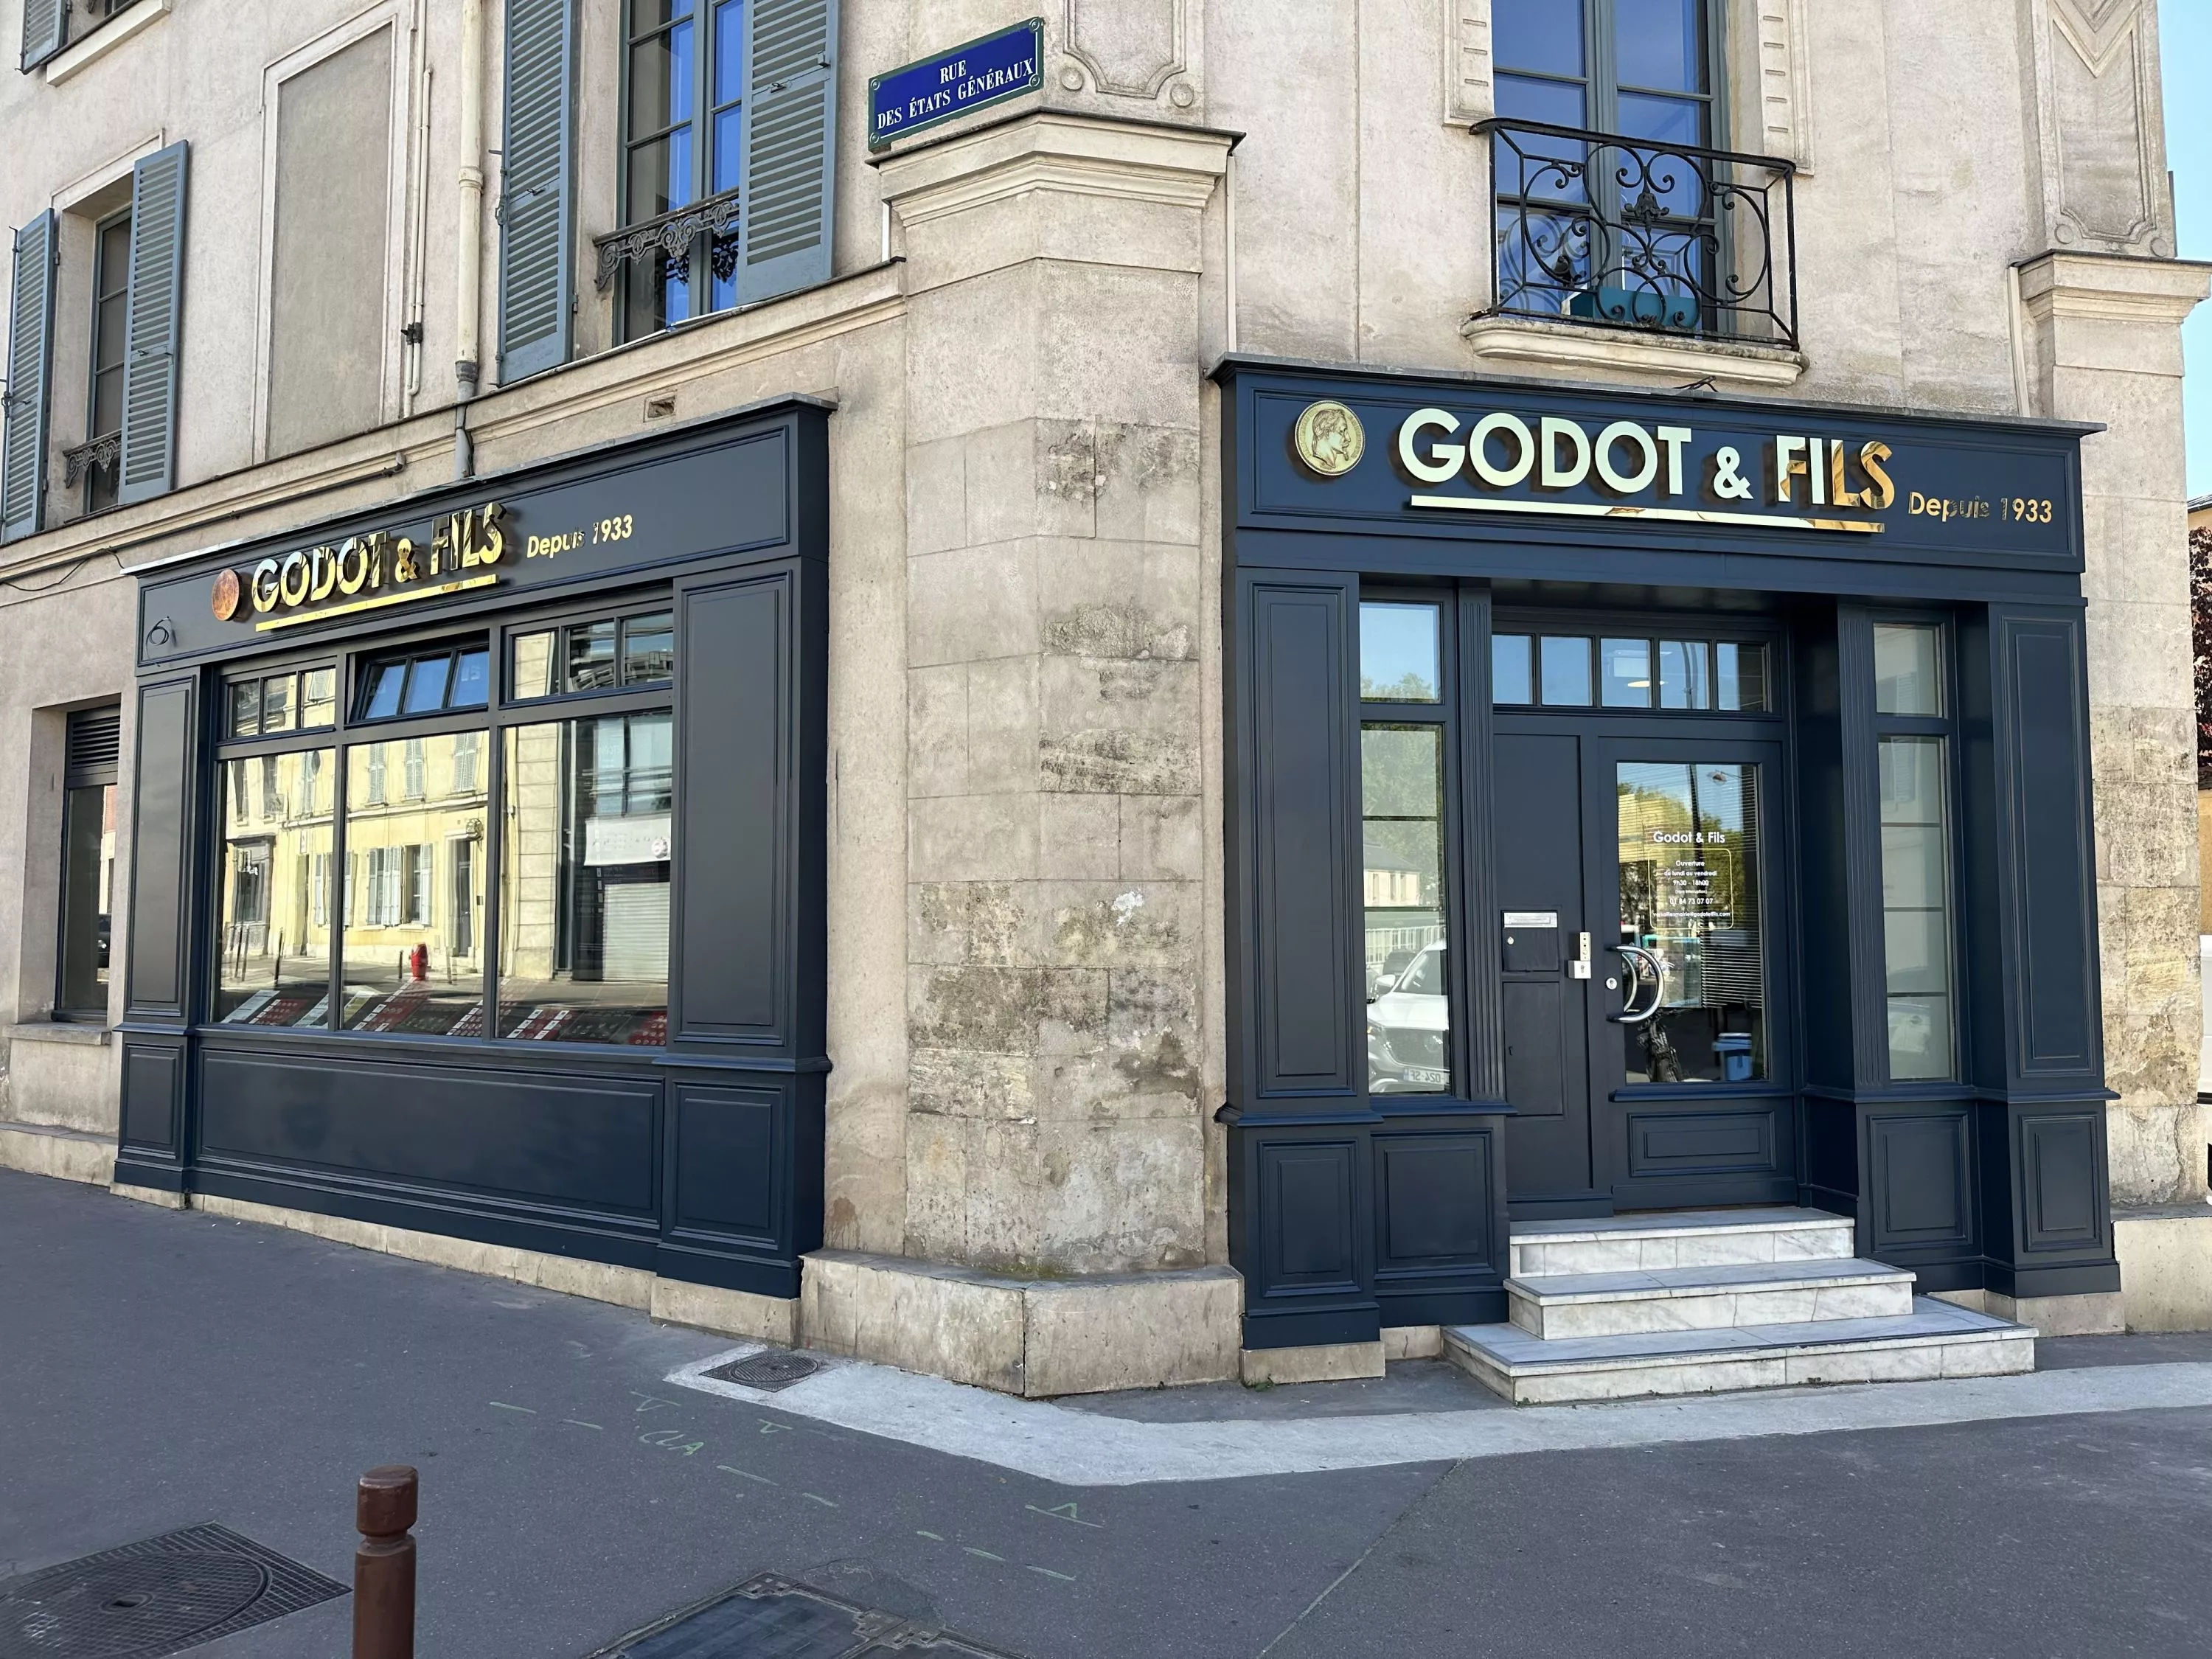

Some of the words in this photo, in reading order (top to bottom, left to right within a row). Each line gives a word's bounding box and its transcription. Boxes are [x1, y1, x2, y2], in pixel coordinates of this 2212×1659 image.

[877, 106, 902, 130] DES
[908, 89, 951, 119] ÉTATS
[958, 58, 1034, 100] GÉNÉRAUX
[939, 60, 967, 84] RUE
[1399, 408, 1693, 495] GODOT
[1713, 446, 1753, 499] &
[1776, 435, 1896, 509] FILS
[1909, 492, 1989, 523] Depuis
[2000, 498, 2052, 523] 1933
[251, 530, 389, 613] GODOT
[395, 538, 419, 582] &
[431, 503, 507, 575] FILS
[526, 526, 587, 559] Depuis
[593, 514, 633, 545] 1933
[1653, 832, 1692, 843] Godot
[1695, 832, 1704, 843] &
[1708, 832, 1725, 843] Fils
